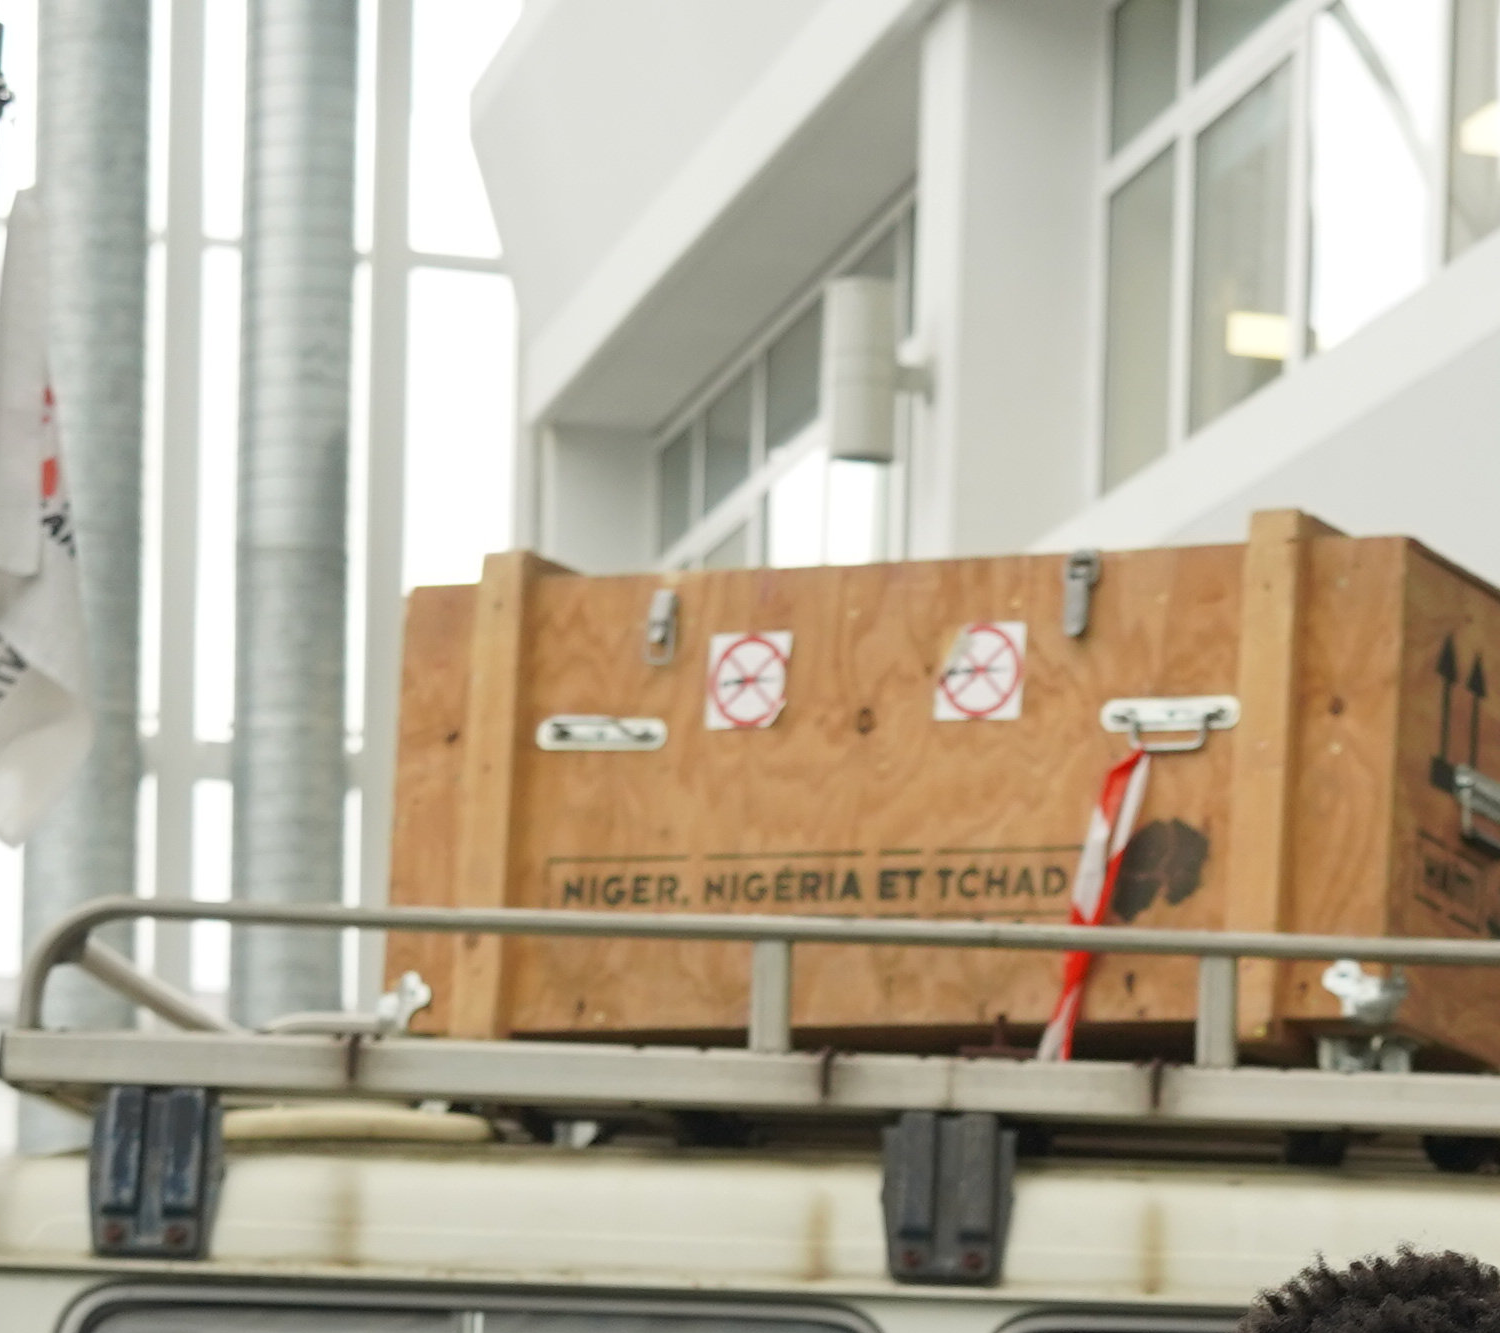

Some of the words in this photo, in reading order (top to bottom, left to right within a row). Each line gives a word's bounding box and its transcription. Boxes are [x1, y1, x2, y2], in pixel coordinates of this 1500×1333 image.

[563, 874, 689, 907] NIGER,
[705, 865, 862, 902] NIGÉRIA
[878, 868, 923, 900] ET
[937, 865, 1068, 899] TCHAD
